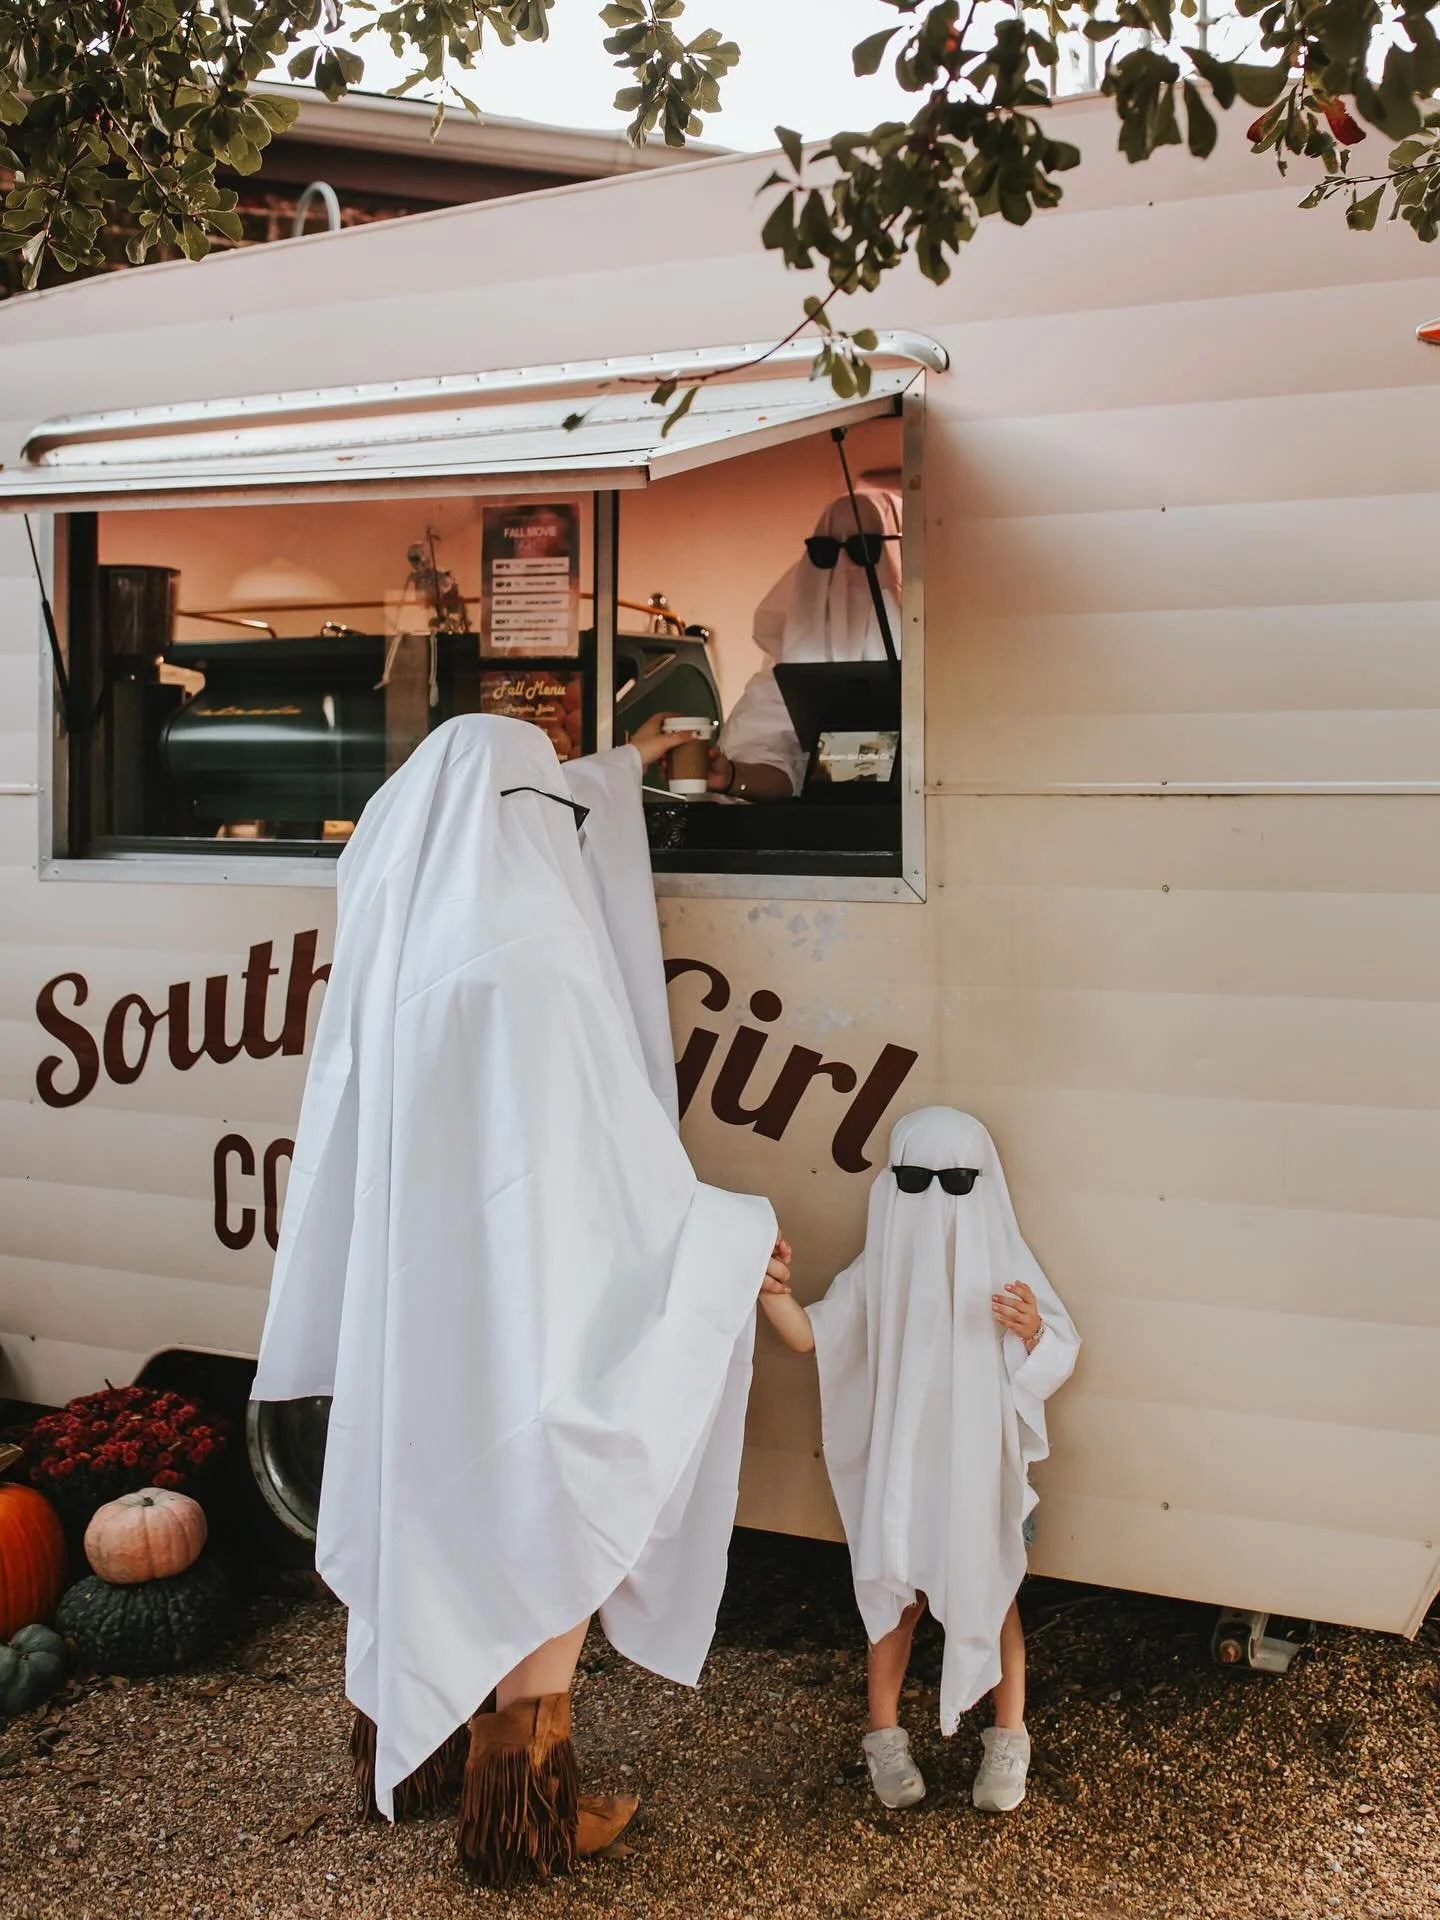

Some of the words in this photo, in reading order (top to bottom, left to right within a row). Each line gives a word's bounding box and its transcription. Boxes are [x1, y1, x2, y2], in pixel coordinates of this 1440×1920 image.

[503, 527, 526, 539] FALL
[527, 526, 557, 537] MOVIE
[493, 680, 525, 700] Fall
[525, 680, 566, 700] Menu
